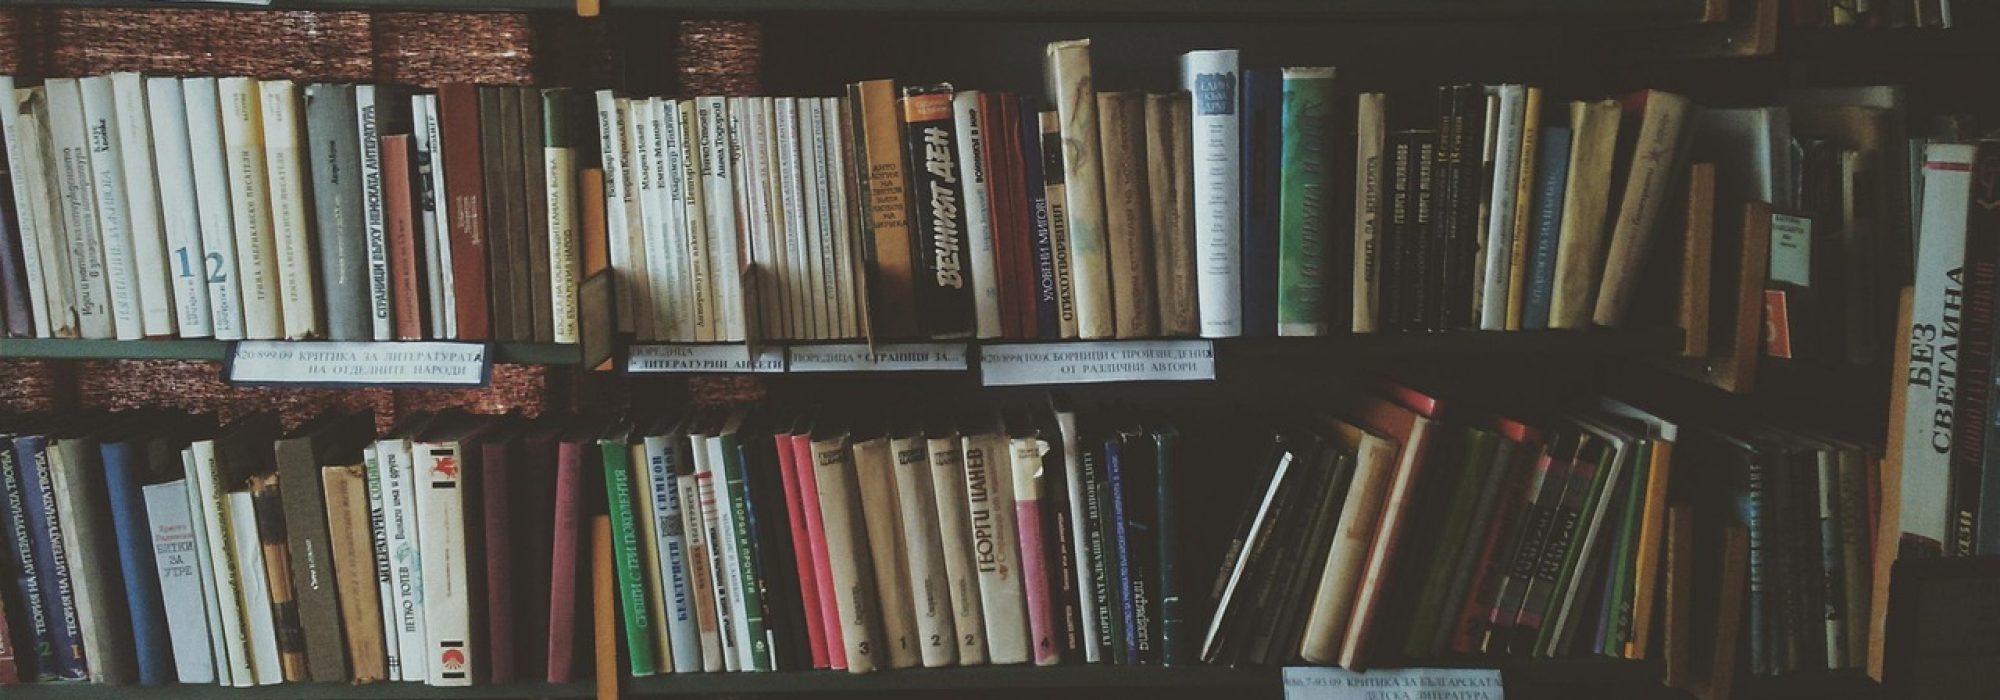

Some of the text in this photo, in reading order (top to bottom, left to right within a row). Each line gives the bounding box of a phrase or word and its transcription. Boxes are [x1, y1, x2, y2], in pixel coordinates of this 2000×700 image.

[651, 119, 663, 158] Манов
[712, 102, 725, 147] Тодоров
[242, 151, 254, 197] ПИСАТЕЛИ
[362, 105, 387, 319] СТРАНИЦИ ВЪРХУ НЕМСКАТА ЛИТЕРАТУРА
[924, 126, 963, 289] ВЕЧНИЯТ ДЕН
[247, 201, 262, 266] АМЕРИКАНСКИ
[1034, 197, 1054, 302] УЛОВЕНИ МИГОВЕ
[175, 247, 195, 277] 1
[205, 252, 228, 283] 2
[1053, 204, 1073, 321] СТИХОТВОРЕНИЯ
[299, 352, 357, 362] КРИТИКА
[363, 352, 378, 362] ЗА
[385, 352, 483, 363] ЛИТЕРАТУРАТА
[630, 347, 693, 357] ПОРЕДИЦА
[793, 353, 854, 363] ПОРЕДИЦА
[1060, 361, 1196, 374] ОТ РАЗЛИЧНИ АВТОРИ
[1907, 323, 1936, 391] БЕЗ
[1931, 266, 1964, 454] СВЕТЛИНА
[309, 366, 466, 377] НА ОТДЕЛНИТЕ НАРОДИ
[652, 455, 667, 511] СИМЕОН
[615, 468, 636, 543] ПОКОЛЕНИЯ
[967, 448, 996, 572] ГЕОРГИ ЦАНЕВ
[1, 449, 48, 636] ТЕОРИЯ НА ЛИТЕРАТУРНАТА ТВОРБА
[34, 450, 78, 637] ТЕОРИЯ НА ЛИТЕРАТУРНАТА ТВОРБА
[626, 548, 639, 571] ТРИ
[399, 566, 410, 596] ТОТЕВ
[629, 573, 640, 581] С
[669, 542, 687, 621] БЕЛЕТРИСТИ
[402, 599, 417, 632] ПЕТКО
[34, 641, 52, 656] 2
[859, 641, 869, 654] 3
[899, 636, 906, 649] 1
[931, 635, 941, 646] 2
[965, 634, 974, 646] 2
[1040, 637, 1050, 648] 4
[1347, 677, 1400, 687] КРИТИКА
